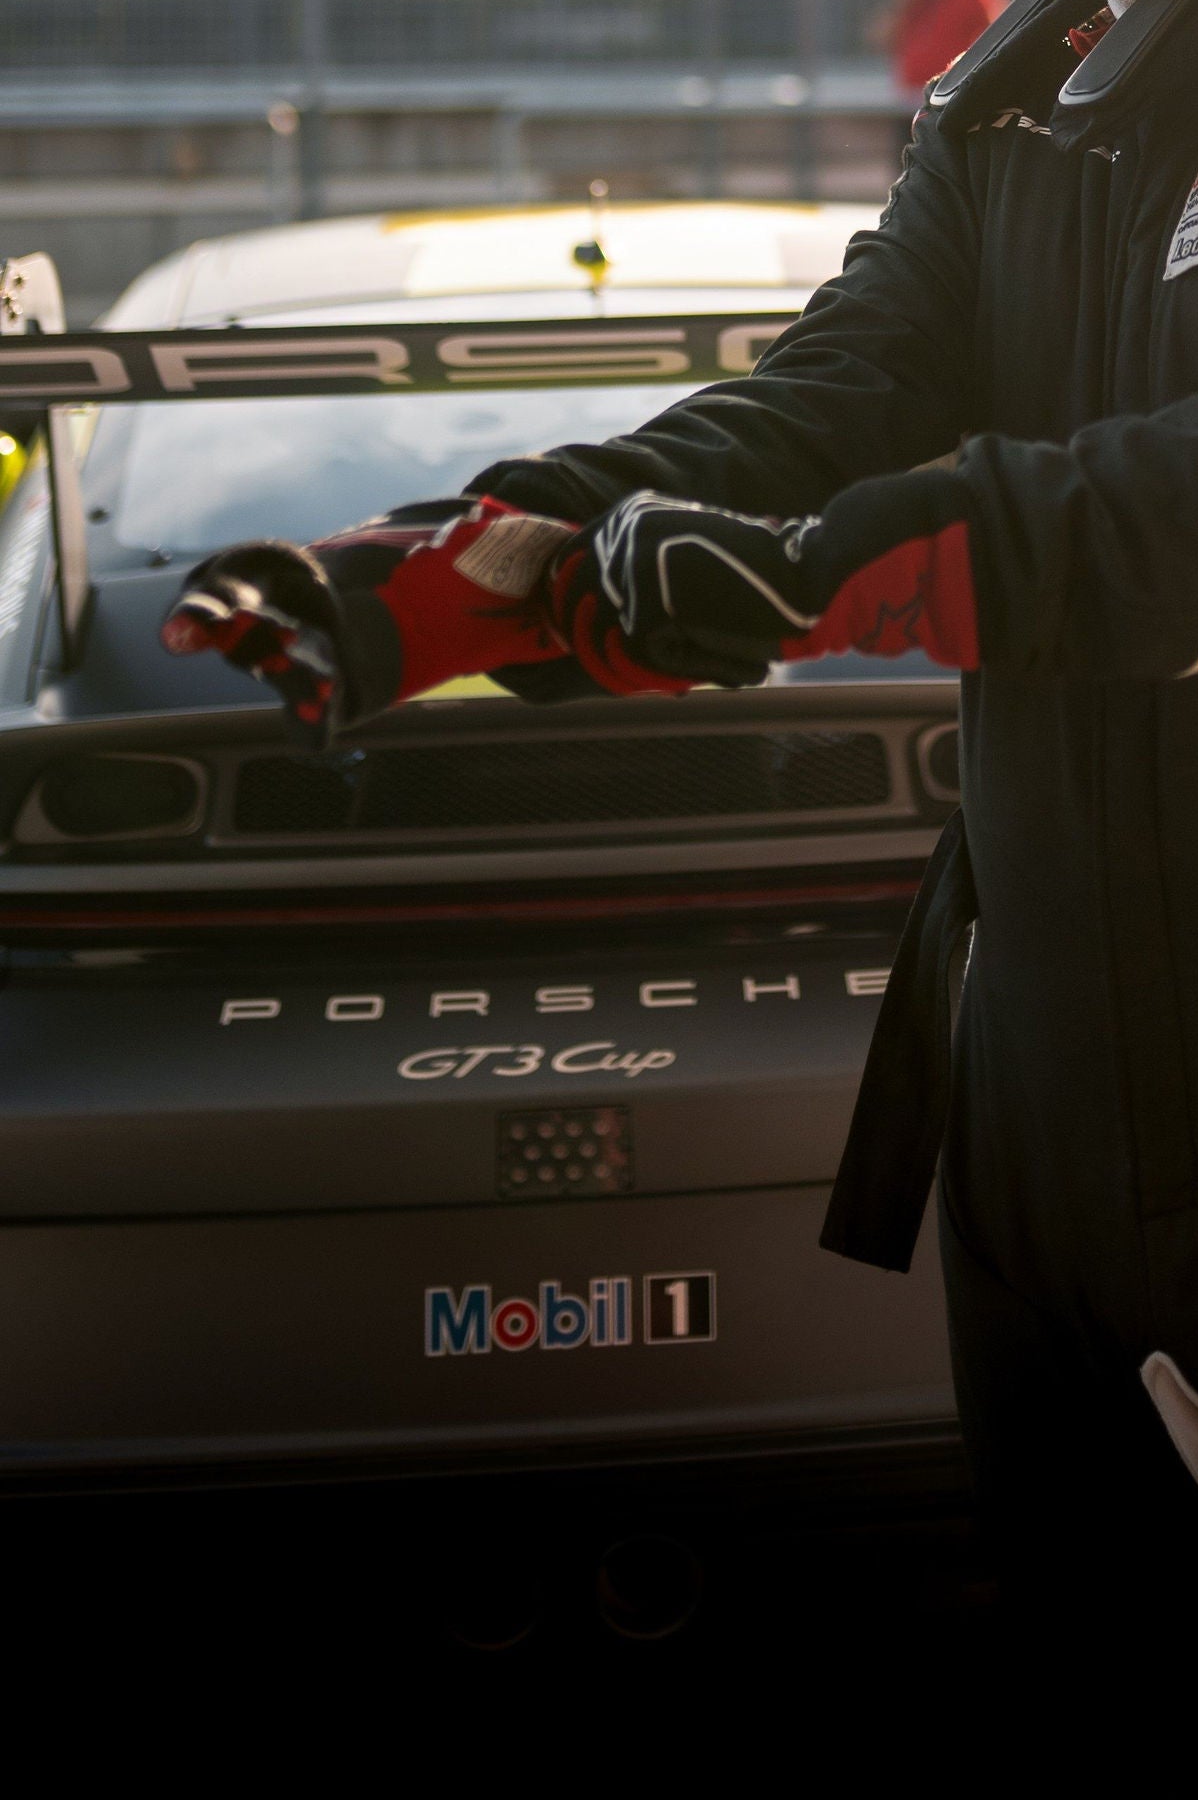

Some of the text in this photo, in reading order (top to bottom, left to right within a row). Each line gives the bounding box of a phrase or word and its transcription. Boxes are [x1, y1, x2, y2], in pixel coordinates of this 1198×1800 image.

[219, 967, 893, 1025] PORSCHE
[397, 1042, 677, 1081] GT3 Cup
[424, 1277, 633, 1357] Mobil
